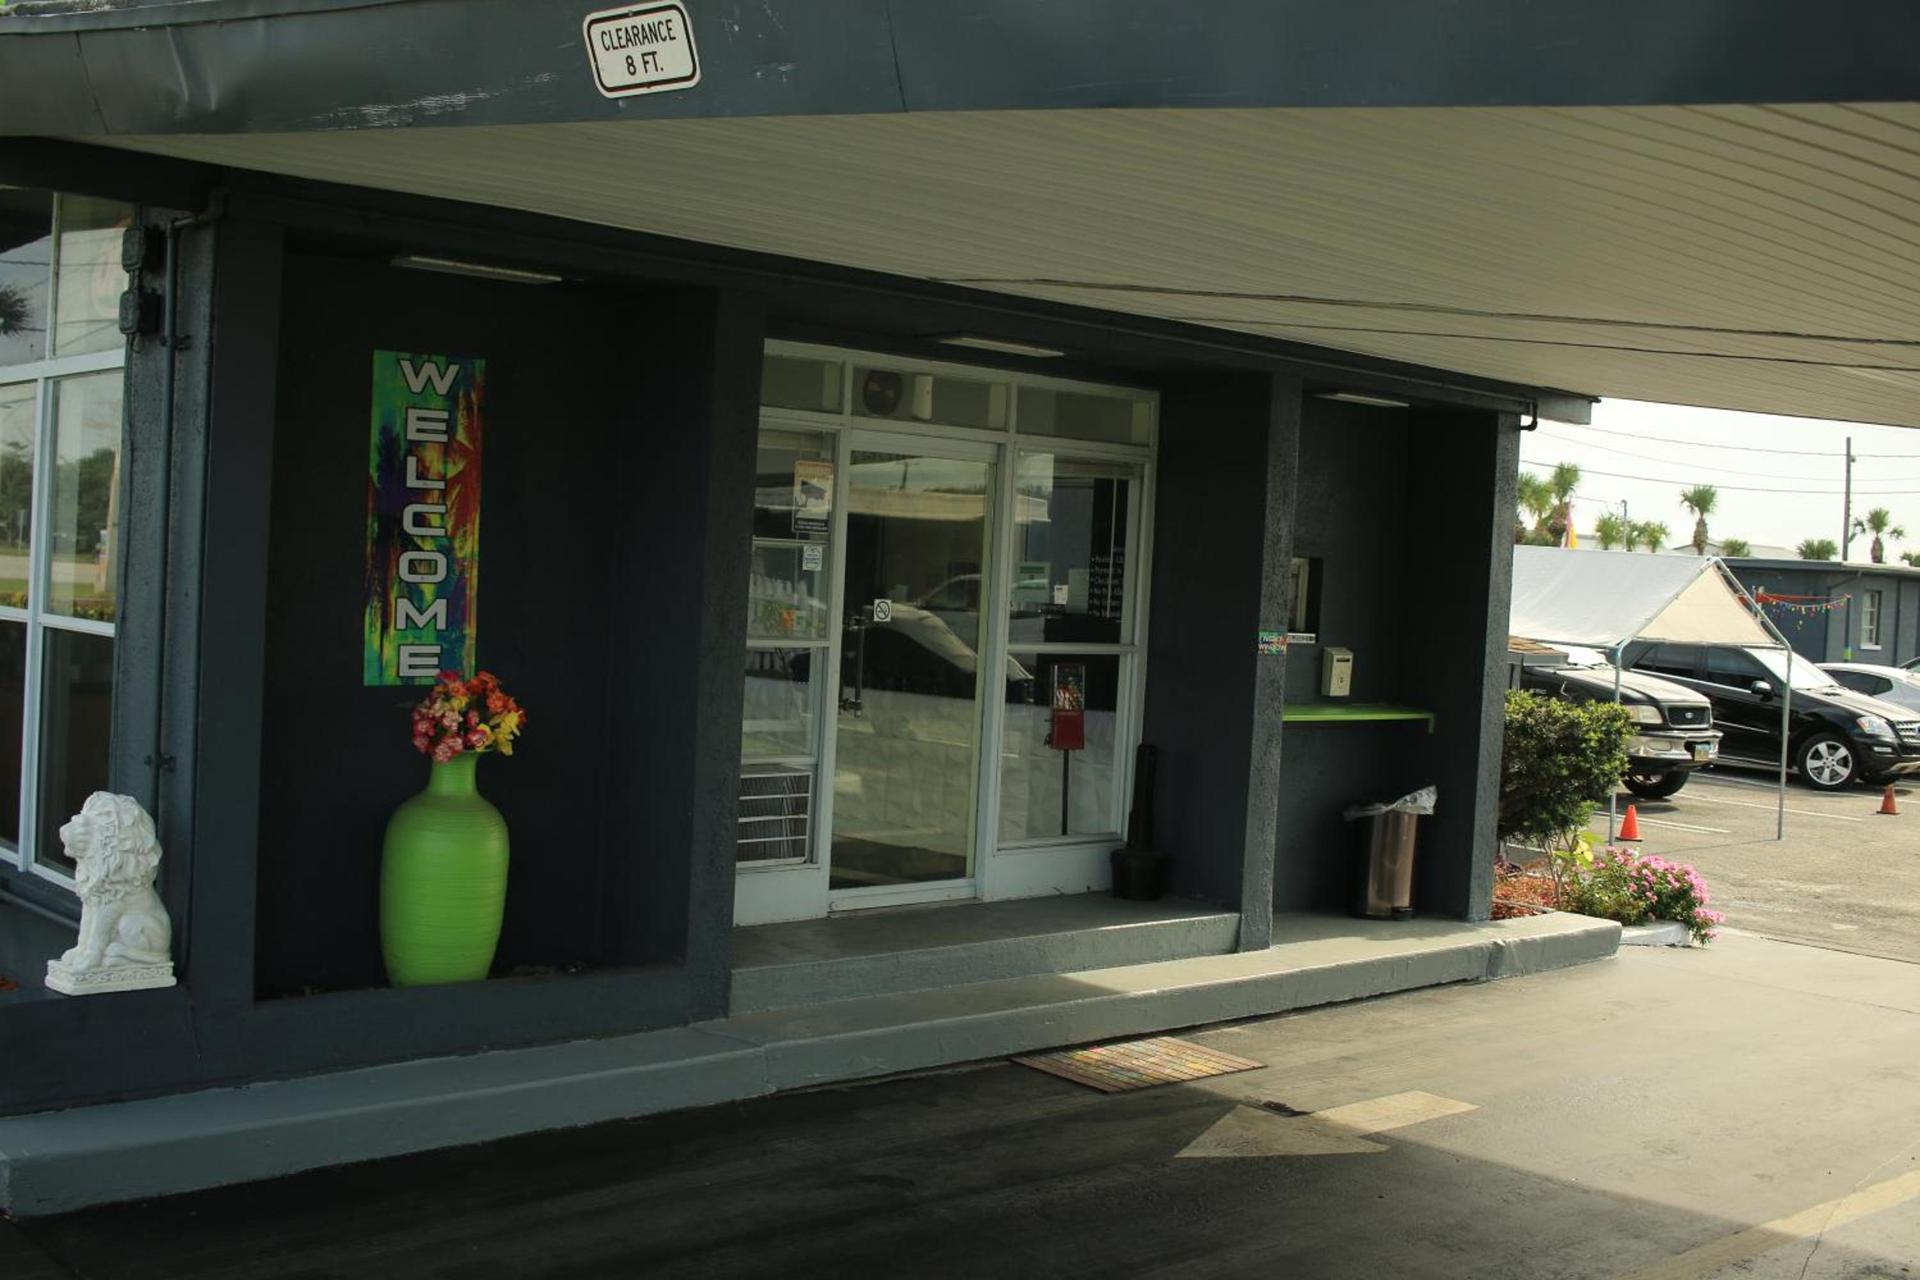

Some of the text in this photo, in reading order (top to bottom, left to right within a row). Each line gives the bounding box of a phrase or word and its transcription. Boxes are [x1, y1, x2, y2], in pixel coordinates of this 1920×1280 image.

[601, 19, 676, 51] CLEARANCE
[625, 51, 664, 76] 8 FT.
[394, 359, 460, 678] WELCOME
